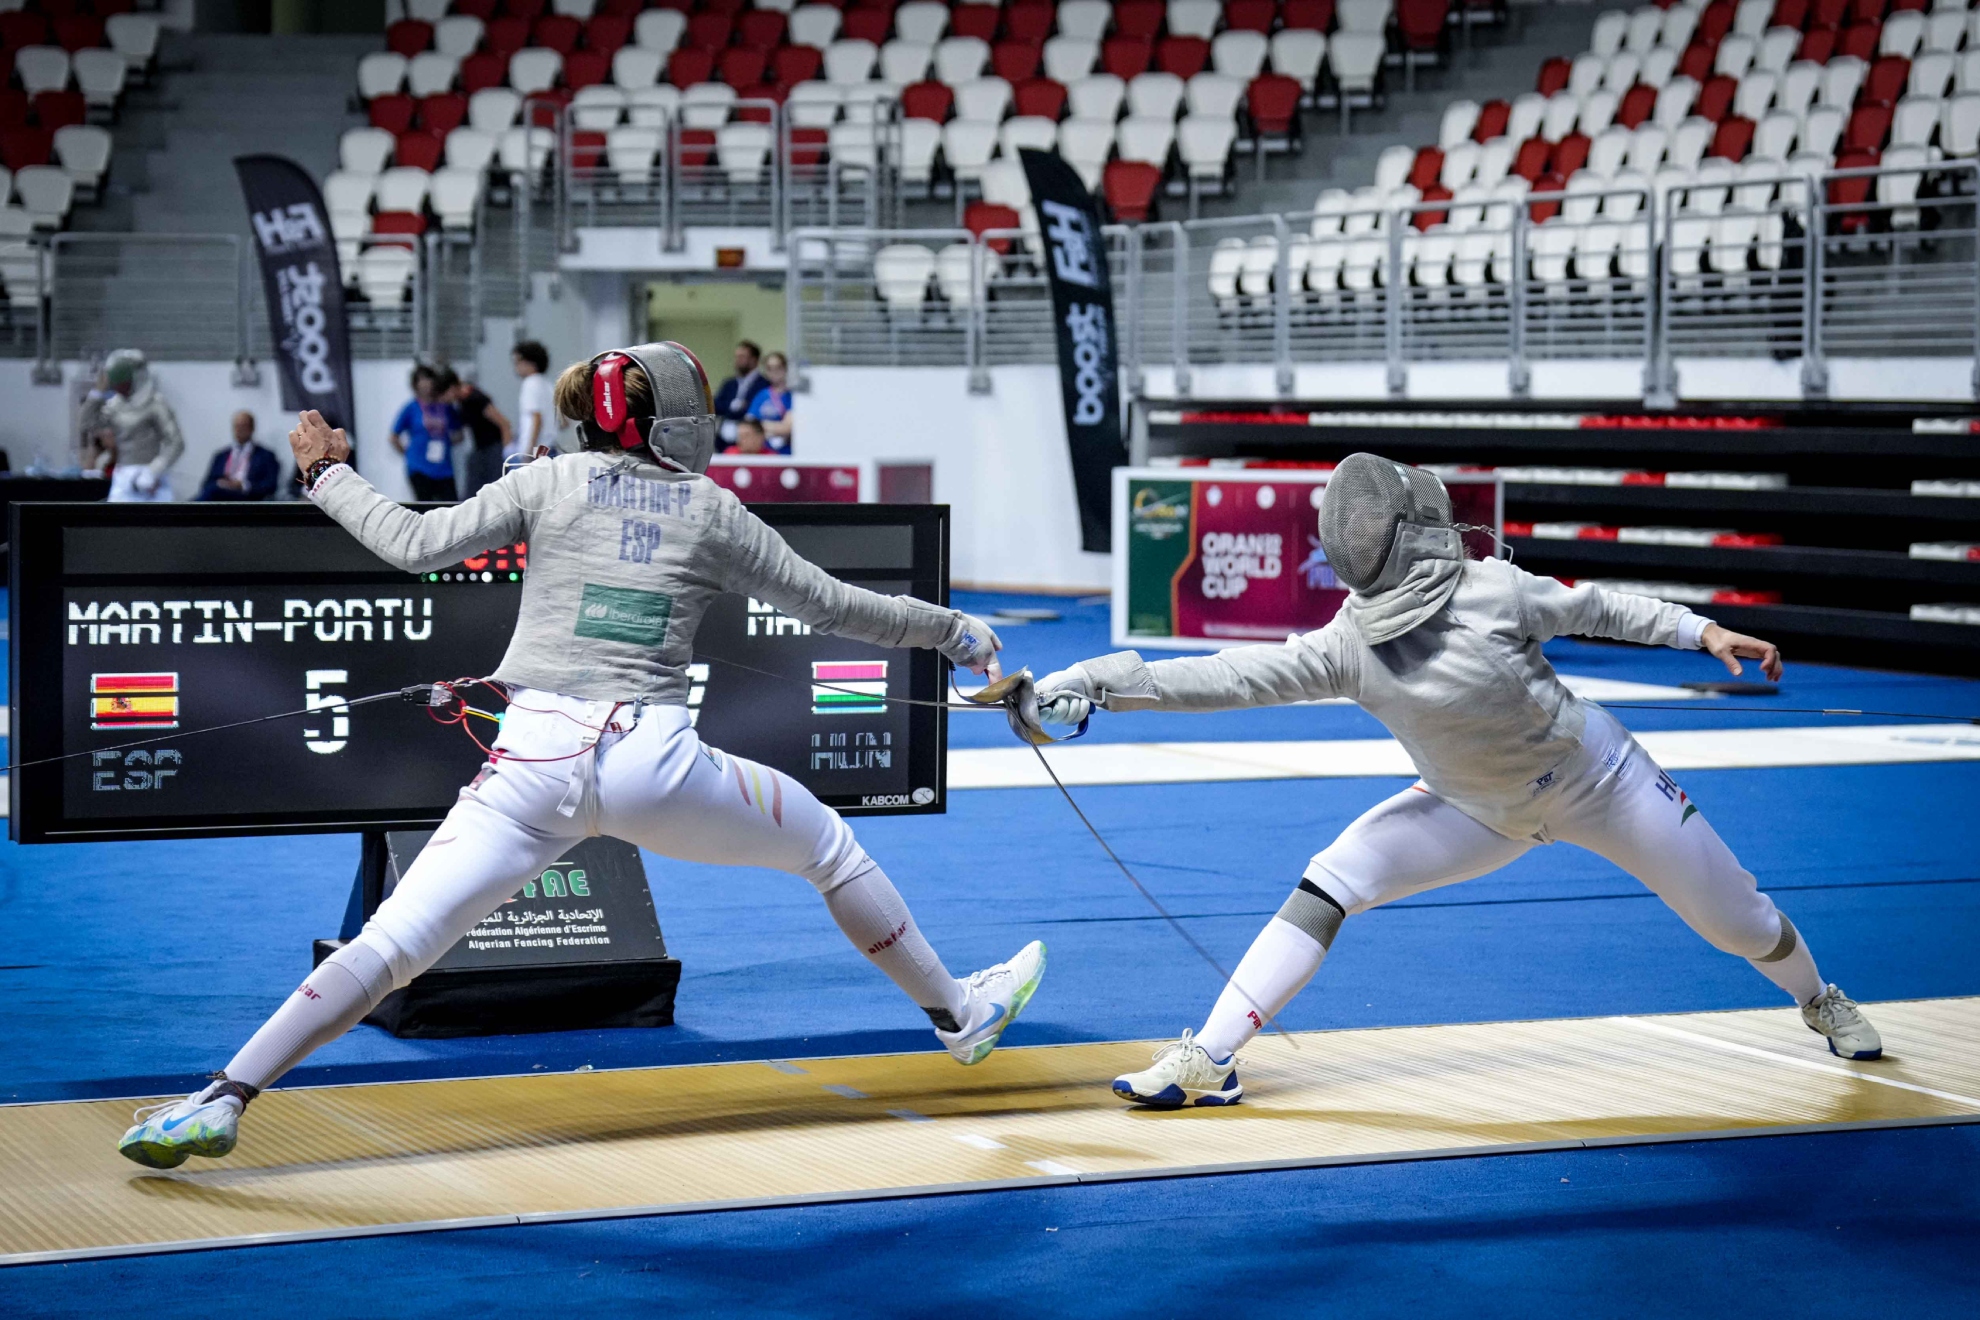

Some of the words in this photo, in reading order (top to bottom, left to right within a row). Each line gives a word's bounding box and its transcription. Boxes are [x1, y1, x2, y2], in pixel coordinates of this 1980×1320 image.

[1066, 302, 1104, 426] boost
[602, 381, 613, 414] allstar
[619, 519, 661, 564] ESP
[1202, 555, 1282, 578] WORLD
[1202, 576, 1248, 599] CUP
[68, 598, 432, 645] MARTIN-PORTU
[304, 669, 349, 754] 5
[810, 732, 892, 769] HUN
[92, 748, 182, 791] ESP
[862, 795, 909, 806] KABCOM
[468, 940, 511, 951] Algerian
[514, 938, 554, 948] Fencing
[557, 936, 610, 946] Federation
[515, 924, 562, 937] Algérienne
[564, 923, 607, 934] d'Escrime
[868, 921, 907, 955] allstar
